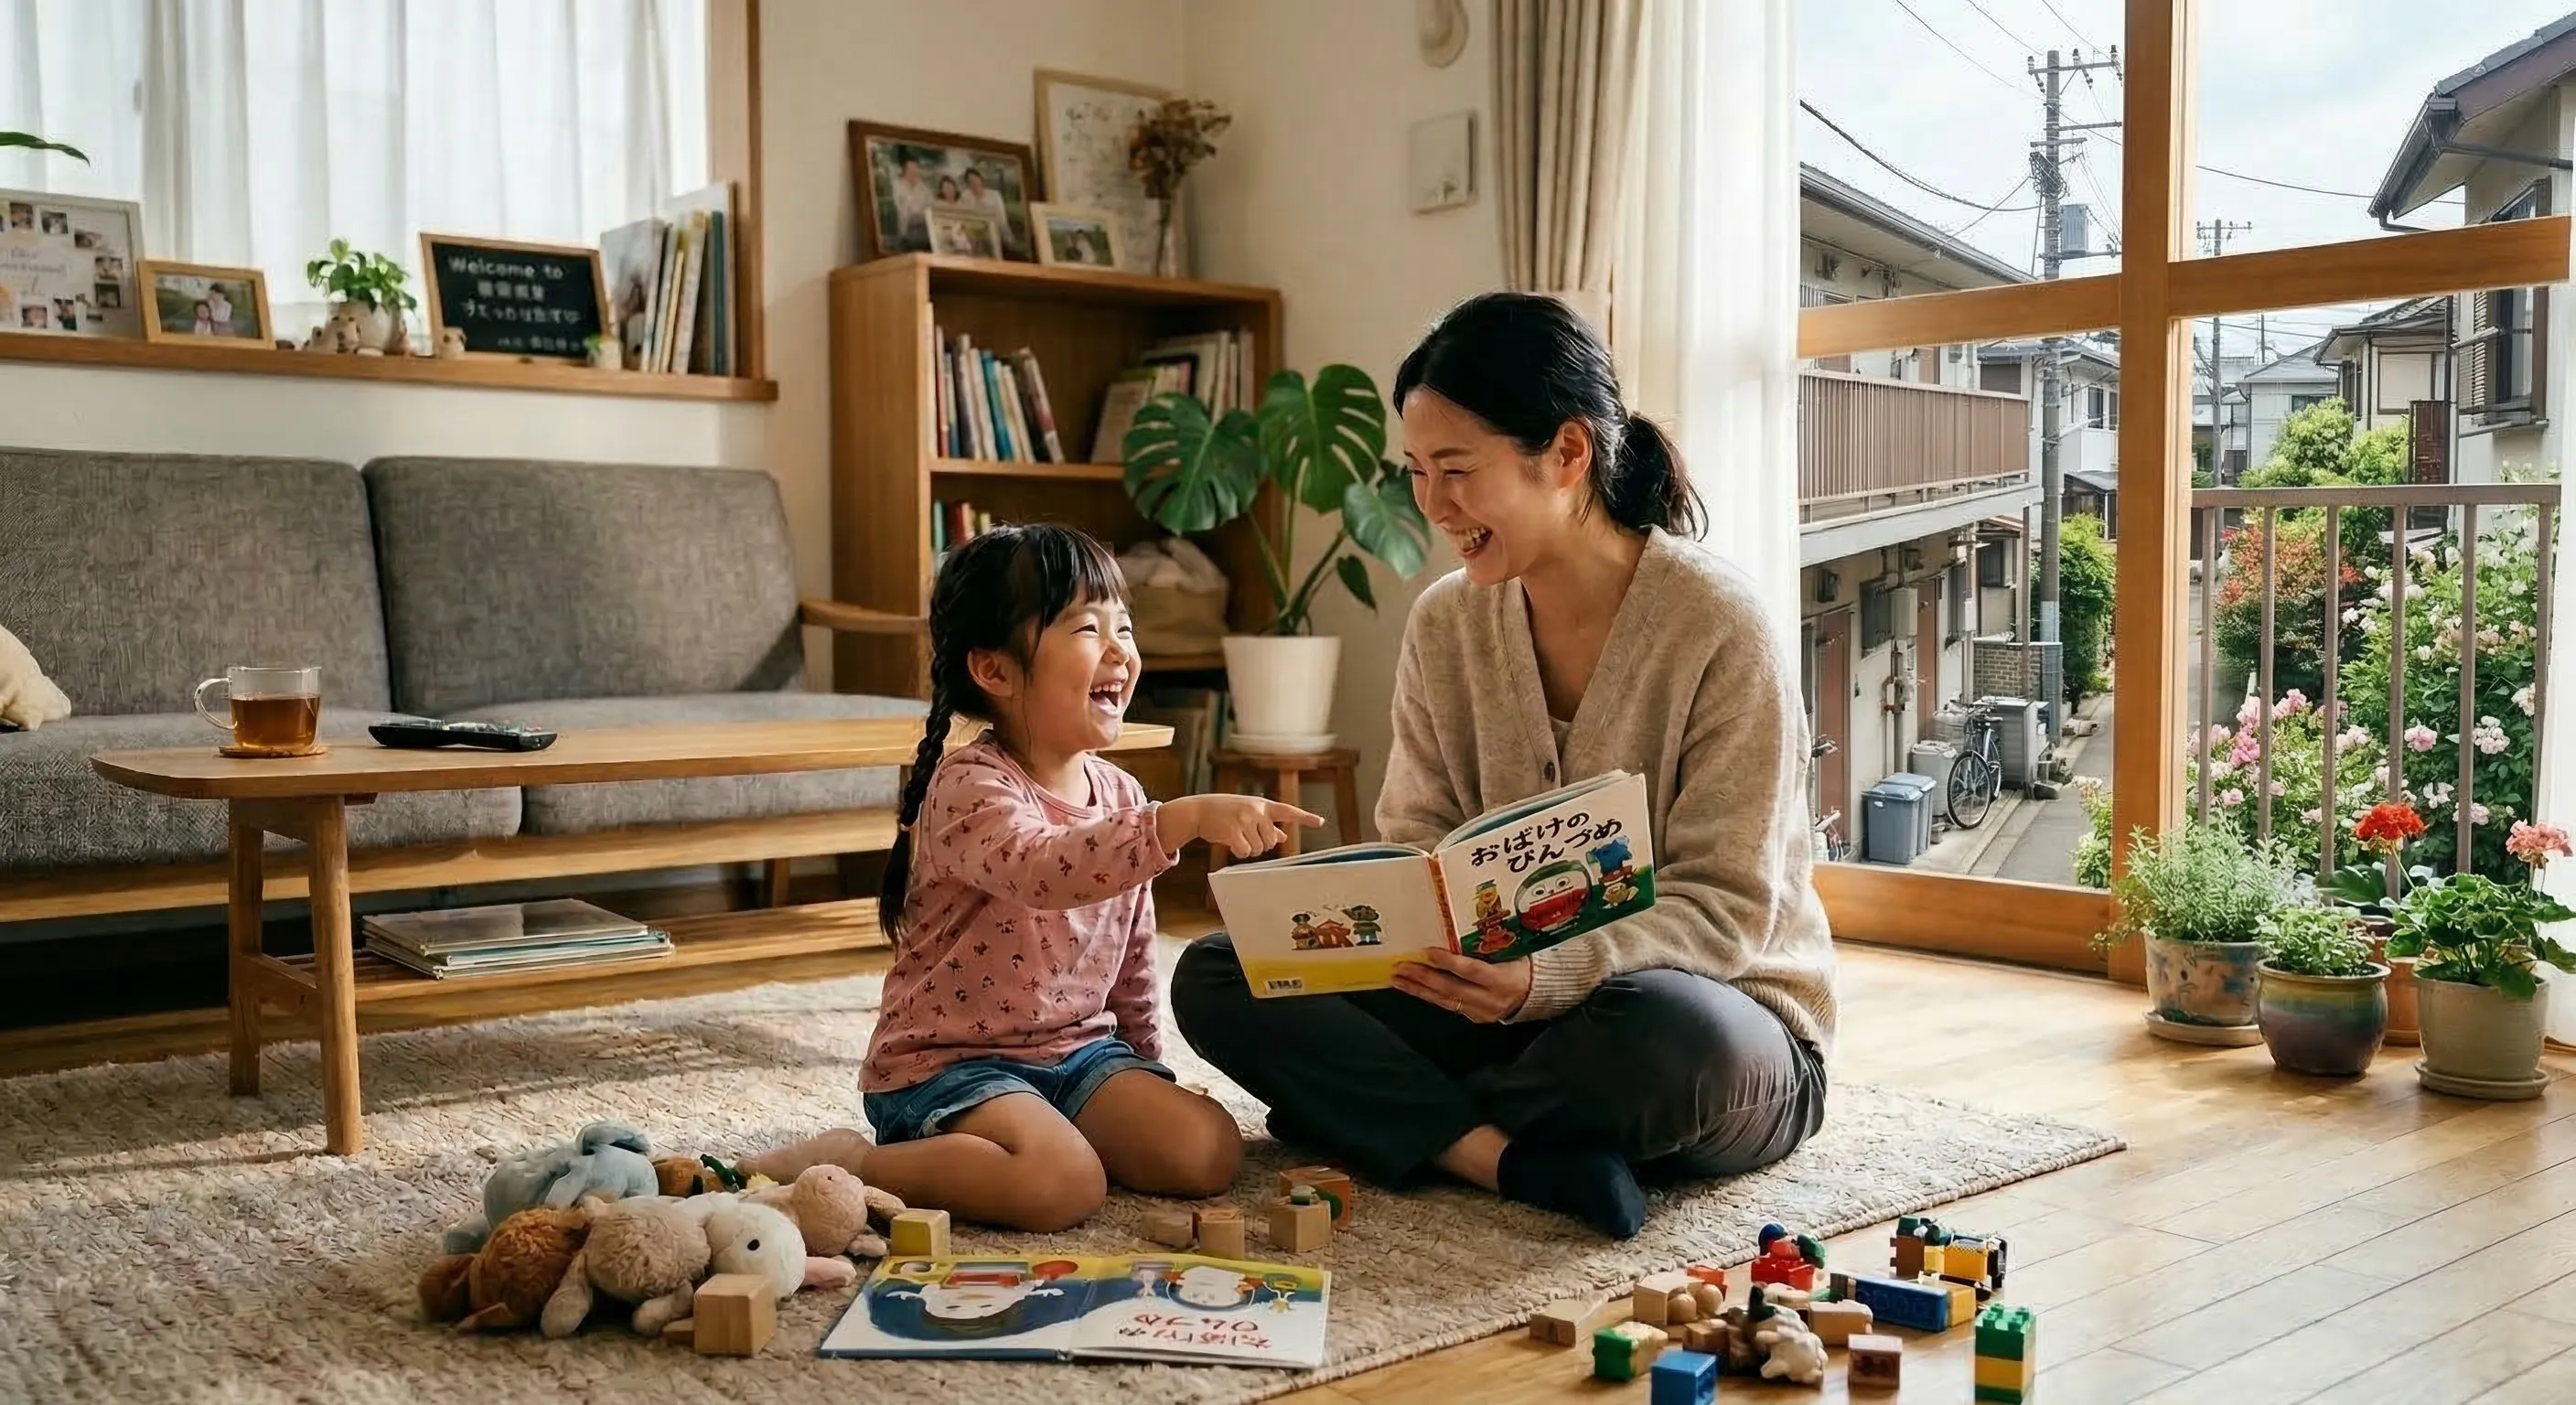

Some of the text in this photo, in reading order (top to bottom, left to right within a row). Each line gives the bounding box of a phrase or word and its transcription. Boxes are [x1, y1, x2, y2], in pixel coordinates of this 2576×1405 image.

[448, 257, 564, 280] Welcome to
[1471, 811, 1591, 867] おばけの
[1508, 818, 1623, 873] びんづめ
